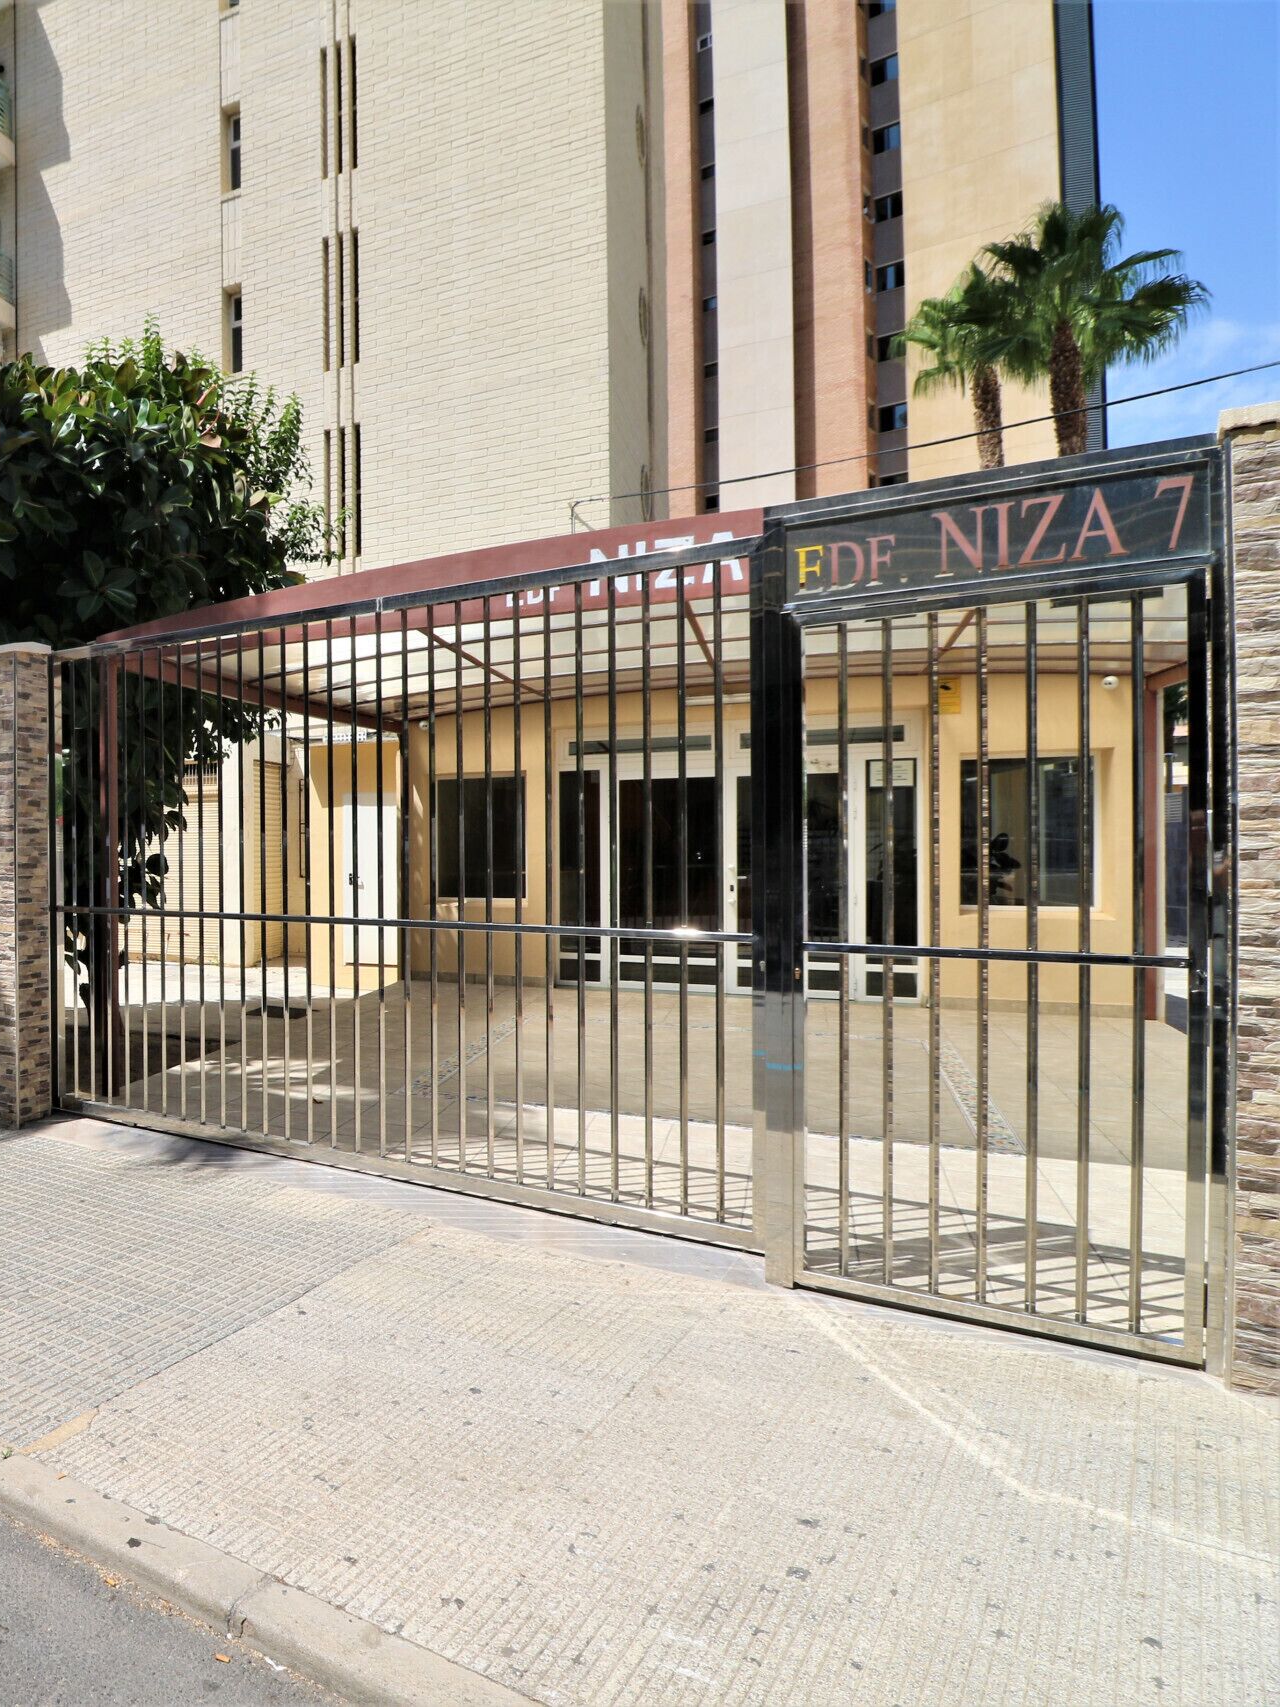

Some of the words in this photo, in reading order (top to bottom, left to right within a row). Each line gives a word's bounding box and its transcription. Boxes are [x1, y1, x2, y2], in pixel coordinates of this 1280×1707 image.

[589, 531, 744, 597] NIZA
[931, 487, 1131, 577] NIZA
[1153, 475, 1195, 552] 7
